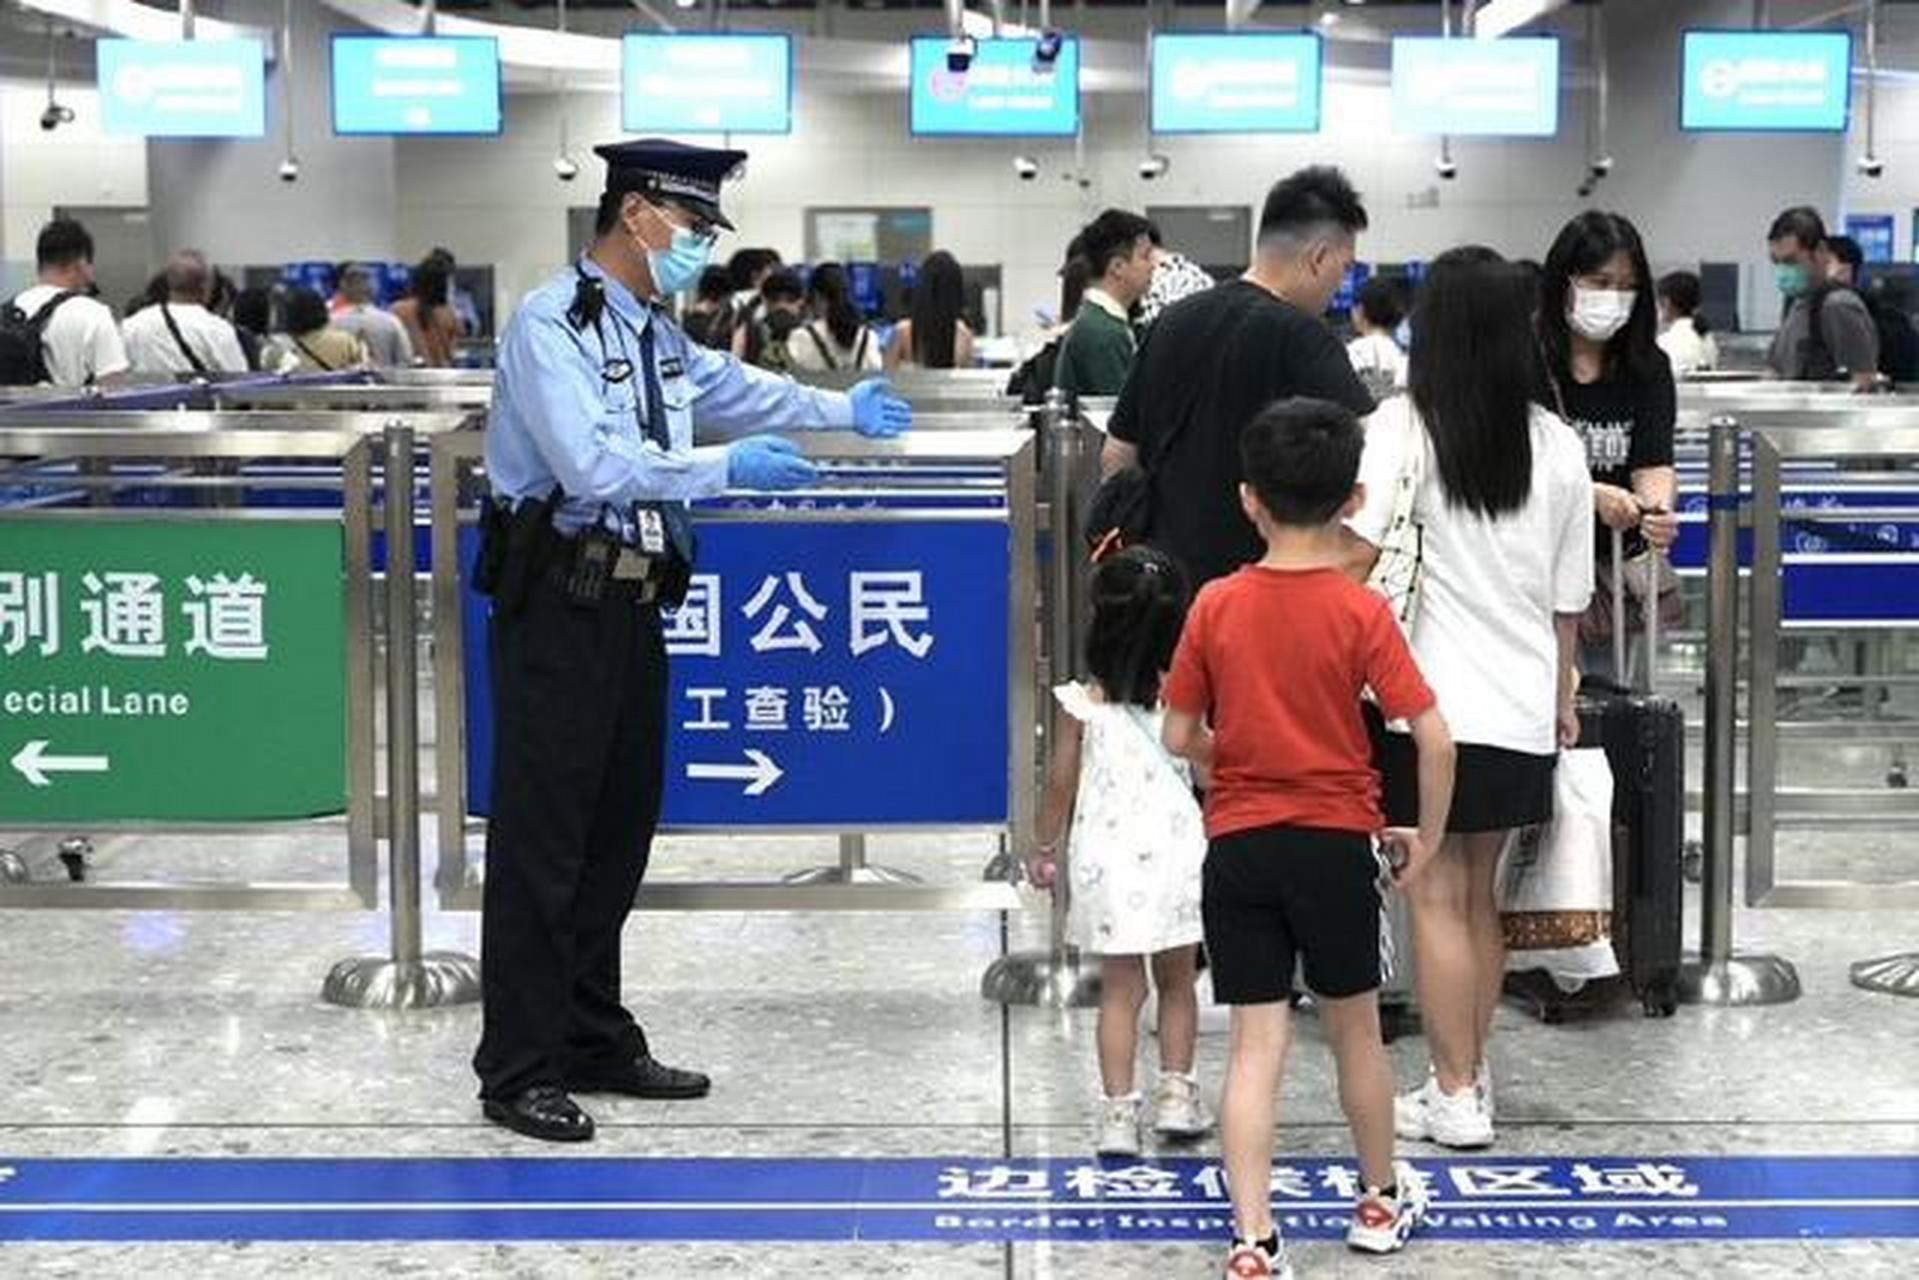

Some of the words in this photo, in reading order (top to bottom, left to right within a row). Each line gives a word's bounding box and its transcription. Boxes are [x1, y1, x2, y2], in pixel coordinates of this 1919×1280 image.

[0, 571, 268, 659] 别通道
[4, 686, 89, 714] ecial
[102, 686, 189, 714] Lane
[934, 1213, 1104, 1229] Border
[1117, 1213, 1353, 1231] Insptio
[1615, 1211, 1728, 1228] Area
